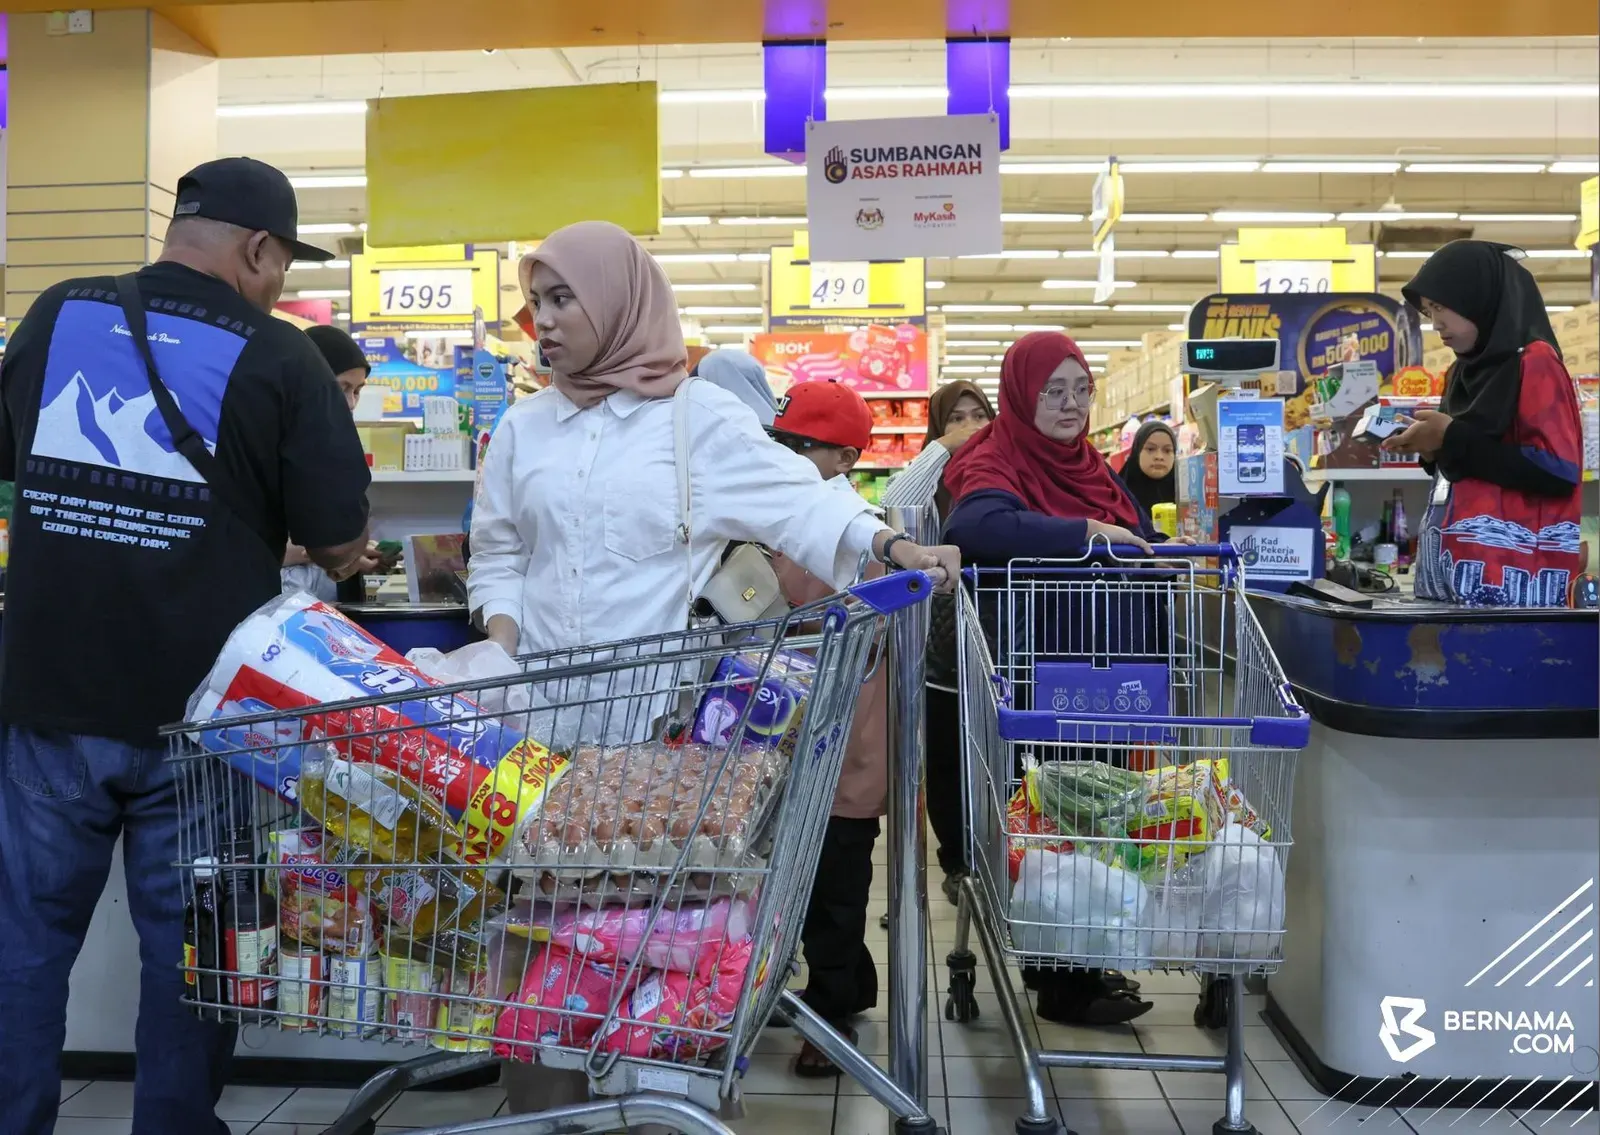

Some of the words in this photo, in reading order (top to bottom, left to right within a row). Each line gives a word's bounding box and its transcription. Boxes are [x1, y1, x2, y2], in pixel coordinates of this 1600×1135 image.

[851, 144, 981, 163] SUMBANGAN
[851, 164, 899, 180] ASAS
[902, 161, 982, 177] RAHMAH
[914, 212, 956, 223] MyKasih
[383, 285, 452, 310] 1595
[158, 333, 181, 344] Down
[775, 342, 812, 354] BOH
[23, 489, 57, 502] EVERY
[60, 495, 86, 507] DAY
[115, 504, 144, 518] NOT
[146, 511, 164, 522] BE
[167, 514, 207, 527] GOOD.
[30, 505, 52, 516] BUT
[55, 509, 96, 524] THERE
[98, 516, 111, 527] IS
[113, 518, 191, 538] SOMETHING
[42, 521, 78, 535] GOOD
[80, 527, 92, 537] IN
[94, 530, 138, 545] EVERY
[140, 538, 171, 550] DAY.
[1261, 537, 1278, 545] Kad
[1260, 555, 1300, 564] MADANI
[1261, 546, 1294, 556] Pekerja
[471, 783, 491, 810] ROLLS
[482, 792, 518, 827] 8
